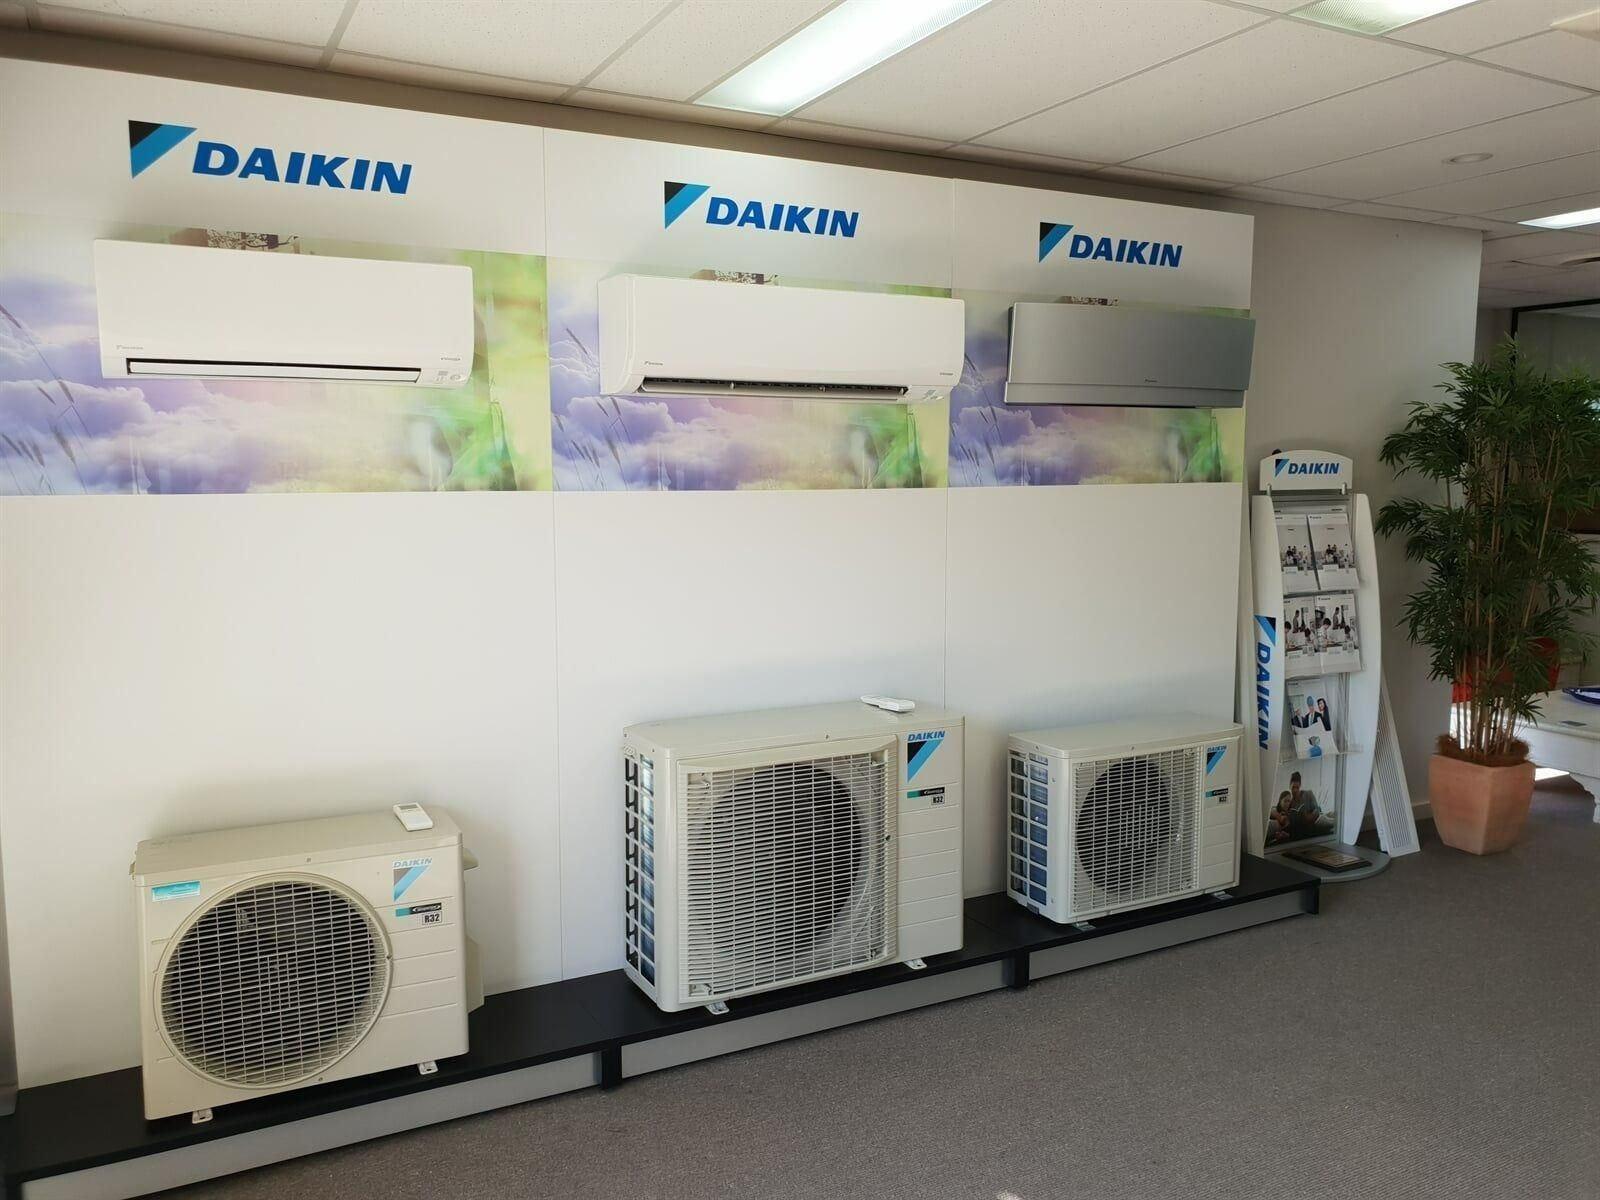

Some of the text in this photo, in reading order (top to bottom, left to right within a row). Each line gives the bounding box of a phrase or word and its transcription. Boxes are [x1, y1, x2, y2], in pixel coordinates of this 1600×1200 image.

[192, 141, 412, 194] DAIKIN
[706, 196, 859, 238] DAIKIN
[1069, 234, 1183, 267] DAIKIN
[1288, 463, 1340, 474] DAIKIN
[1256, 642, 1271, 750] DAIKIN
[908, 731, 945, 741] DAIKIN
[393, 857, 432, 868] DAIKIN
[424, 913, 440, 923] R32
